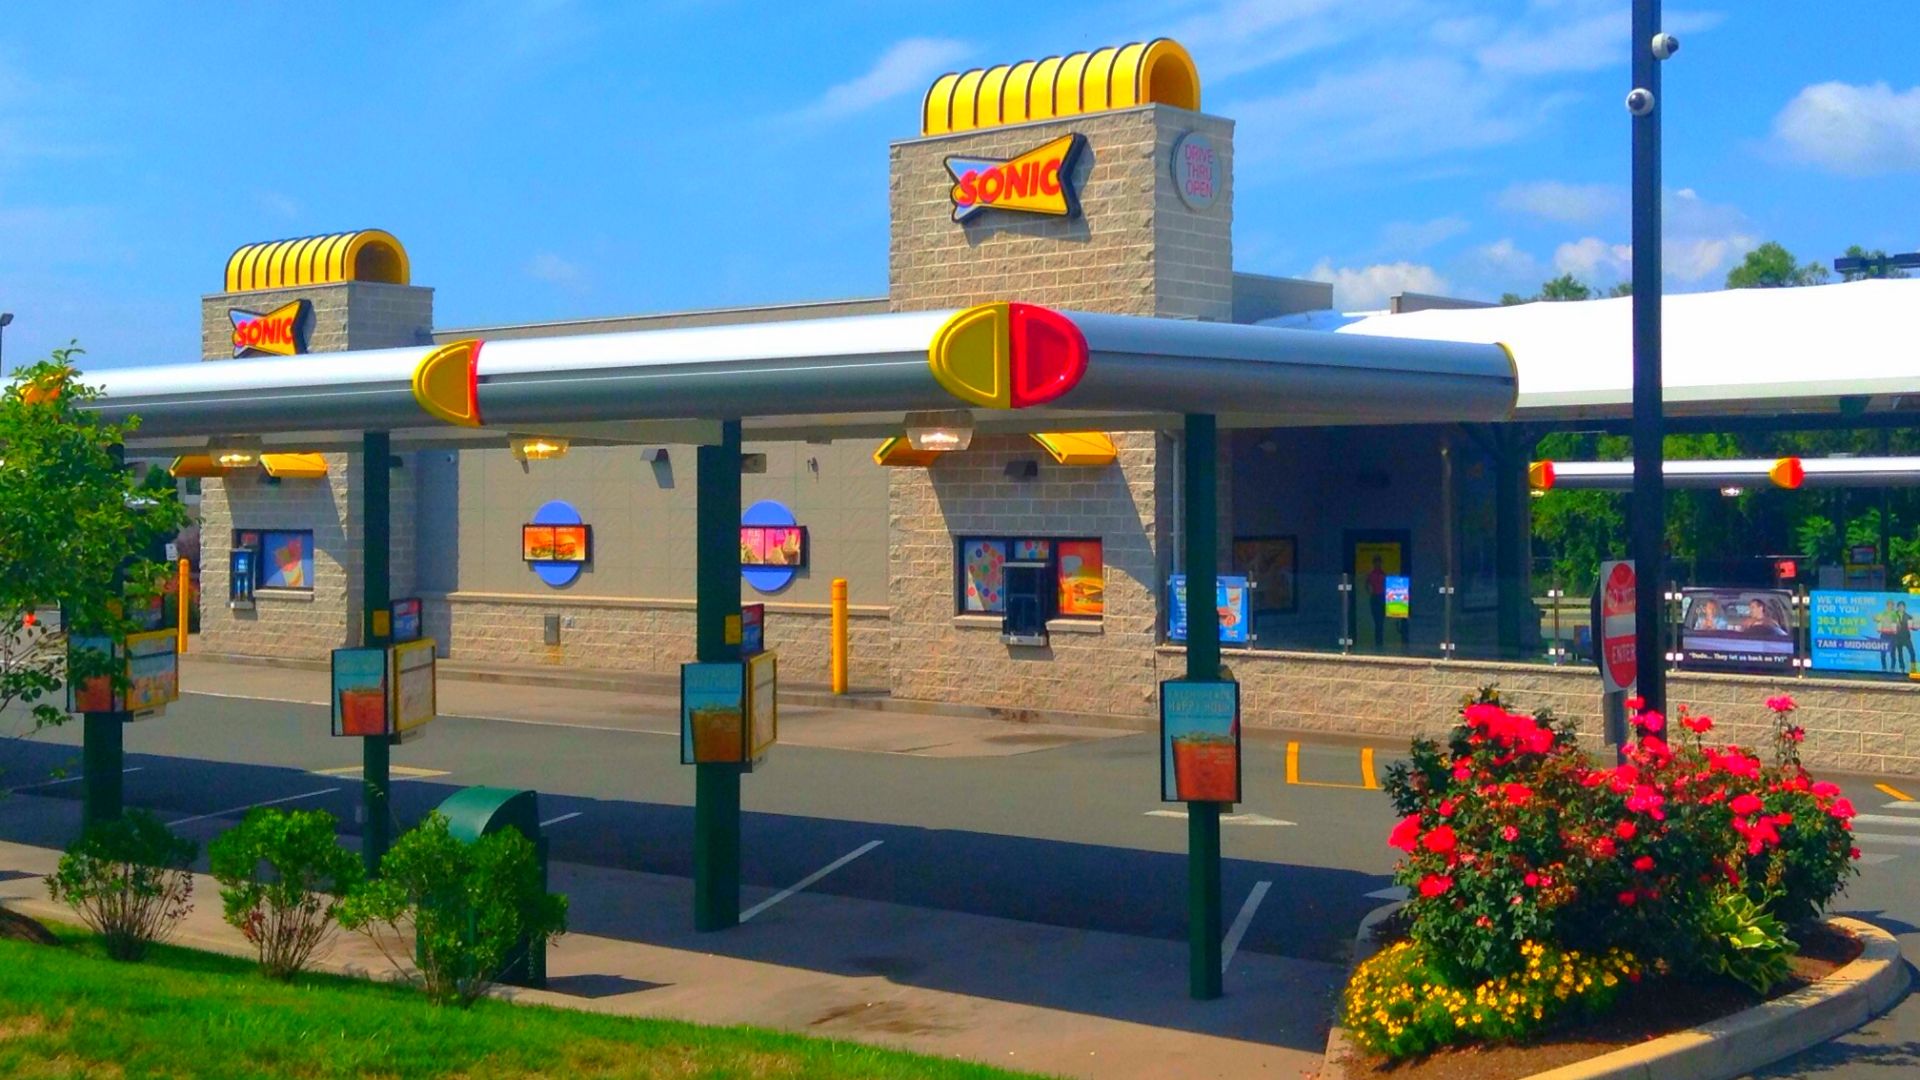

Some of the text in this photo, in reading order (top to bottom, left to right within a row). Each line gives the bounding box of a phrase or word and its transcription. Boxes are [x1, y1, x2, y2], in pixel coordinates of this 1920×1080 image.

[1185, 144, 1213, 164] DRIVE
[1186, 162, 1213, 181] THRU
[957, 158, 1062, 207] SONIC
[1185, 179, 1213, 198] OPEN
[236, 317, 293, 347] SONIC
[1817, 605, 1860, 614] FOR YOU
[1817, 626, 1825, 635] A
[1818, 640, 1837, 648] 7AM
[1844, 641, 1889, 650] MIDNIGHT
